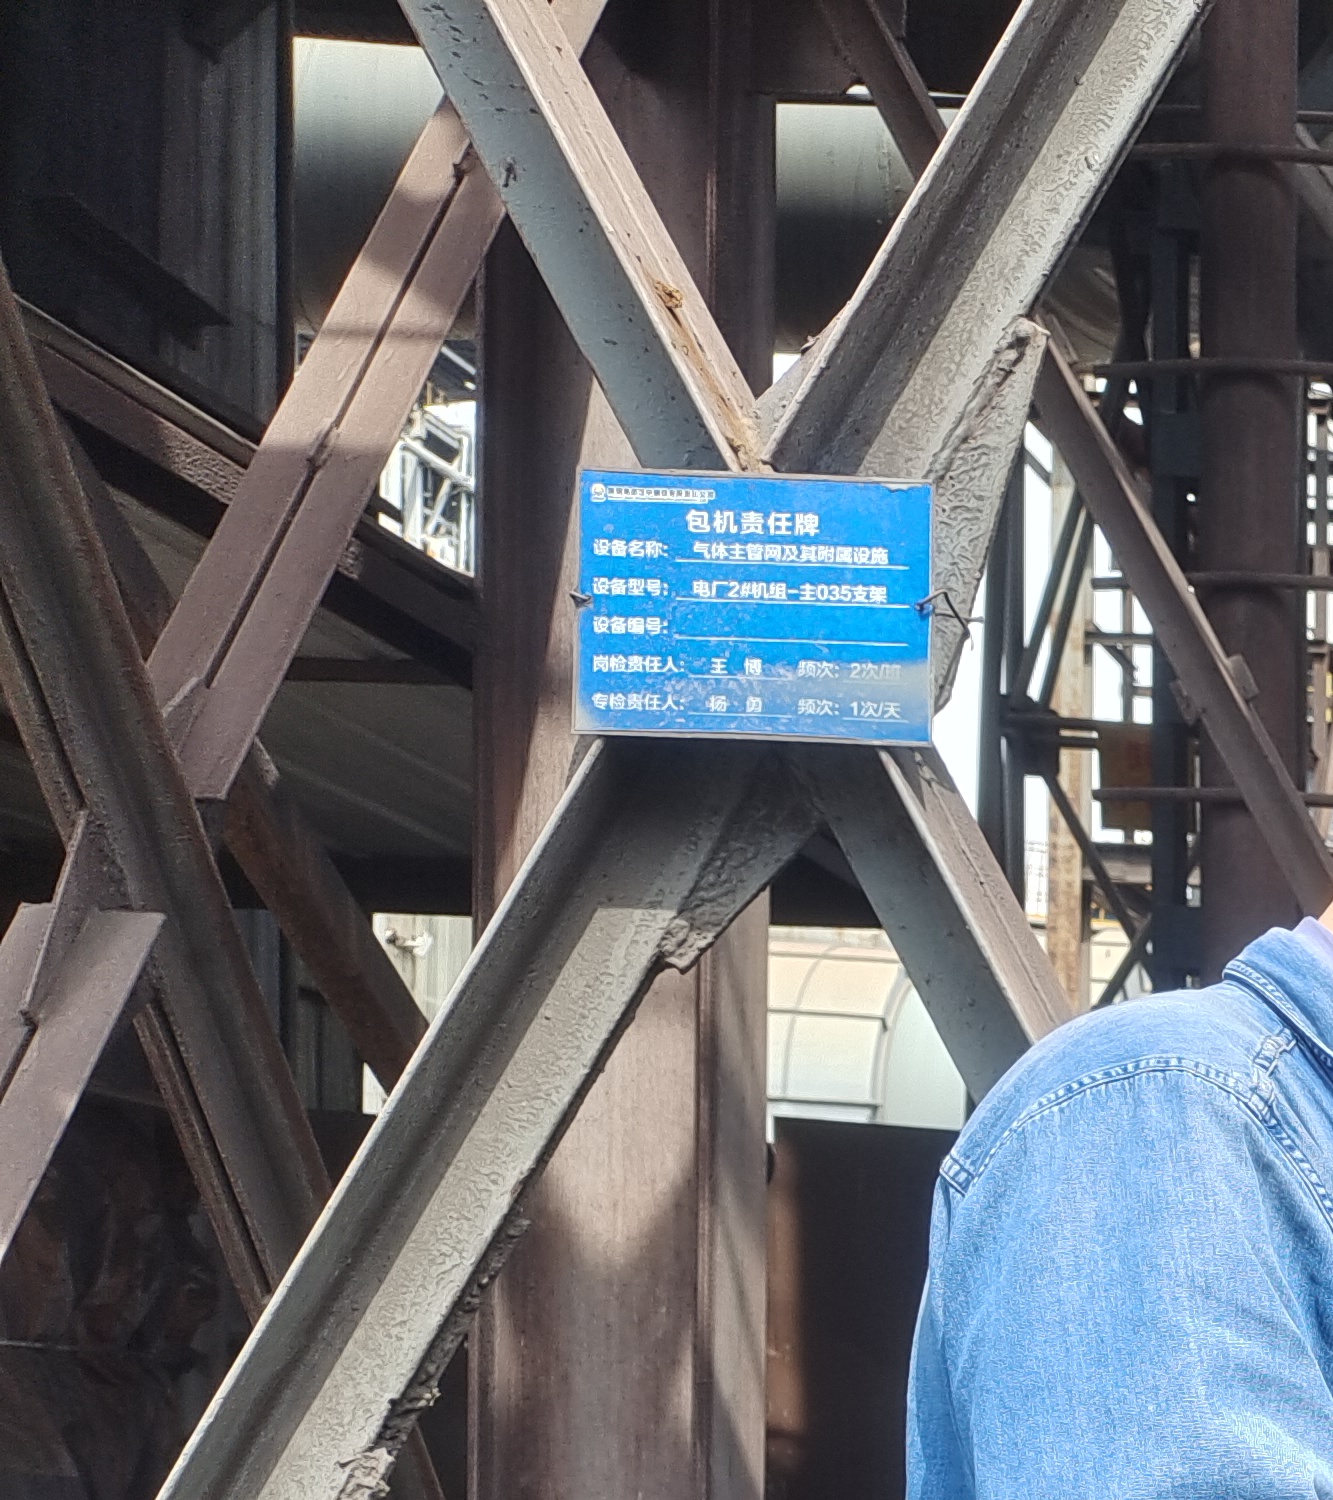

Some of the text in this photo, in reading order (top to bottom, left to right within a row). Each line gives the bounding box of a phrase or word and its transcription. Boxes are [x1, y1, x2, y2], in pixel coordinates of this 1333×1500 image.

[686, 510, 820, 537] 包机责任牌
